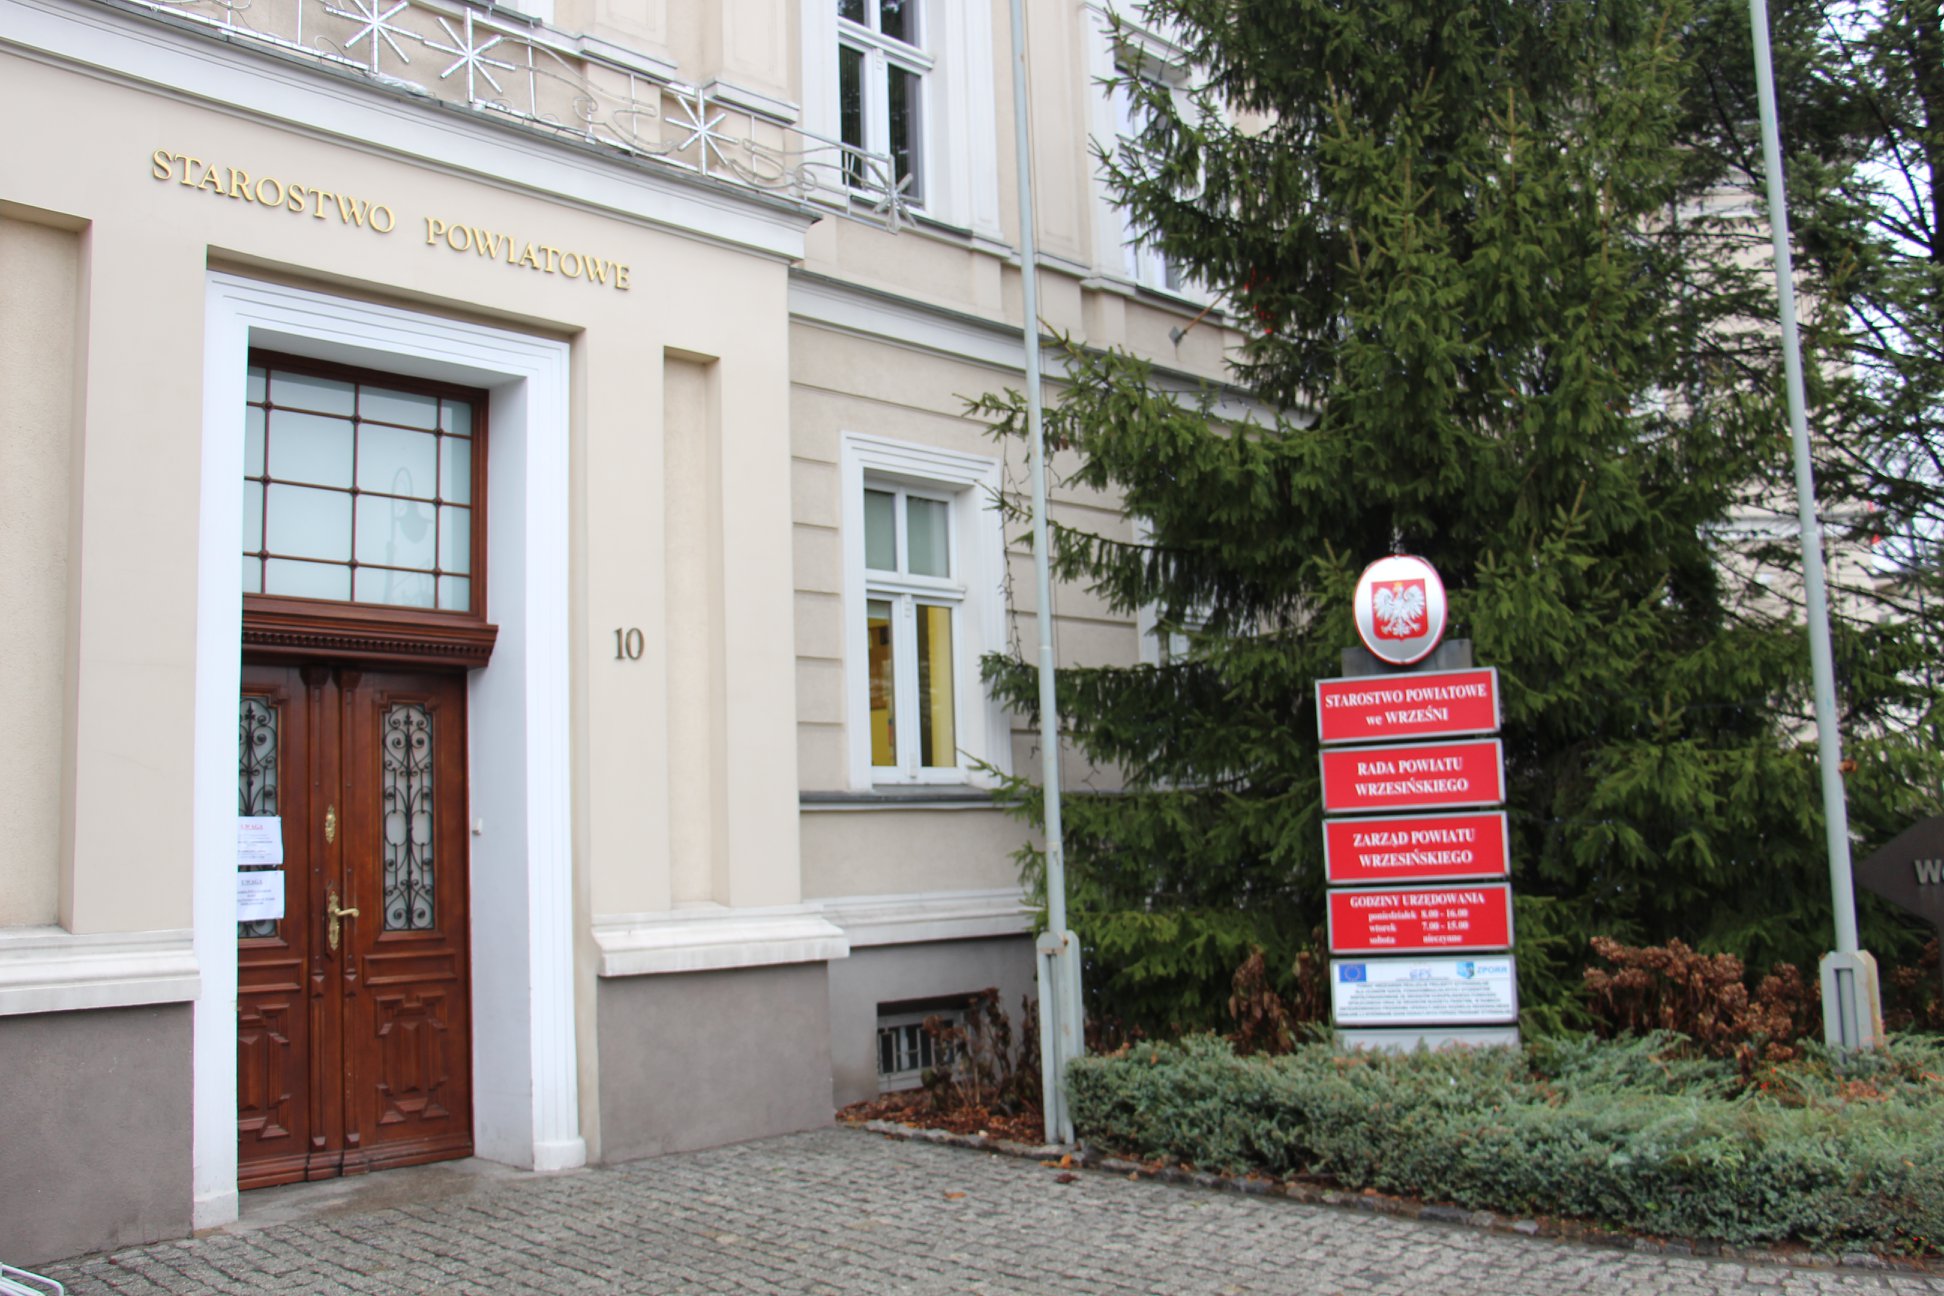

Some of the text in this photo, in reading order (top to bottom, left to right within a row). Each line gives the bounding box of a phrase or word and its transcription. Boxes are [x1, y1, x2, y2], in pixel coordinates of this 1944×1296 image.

[151, 148, 632, 291] STAROSTWO POWIATOWE
[613, 627, 645, 660] 10
[1325, 683, 1487, 708] STAROSTWO POWIATOWE
[1366, 705, 1449, 726] we WRZEŚNI
[1357, 757, 1463, 776] RADA POWIATU
[1355, 777, 1469, 797] WRZESIŃSKIEGO
[1353, 828, 1475, 848] ZARZĄD POWIATU
[1359, 848, 1473, 868] WRZESIŃSKIEGO
[1913, 859, 1944, 884] W
[1350, 892, 1485, 908] GODZINY URZĘDOWANIA
[1369, 923, 1397, 933] wtorek
[1422, 921, 1440, 931] 7.00
[1369, 933, 1462, 945] sobota nieczynne
